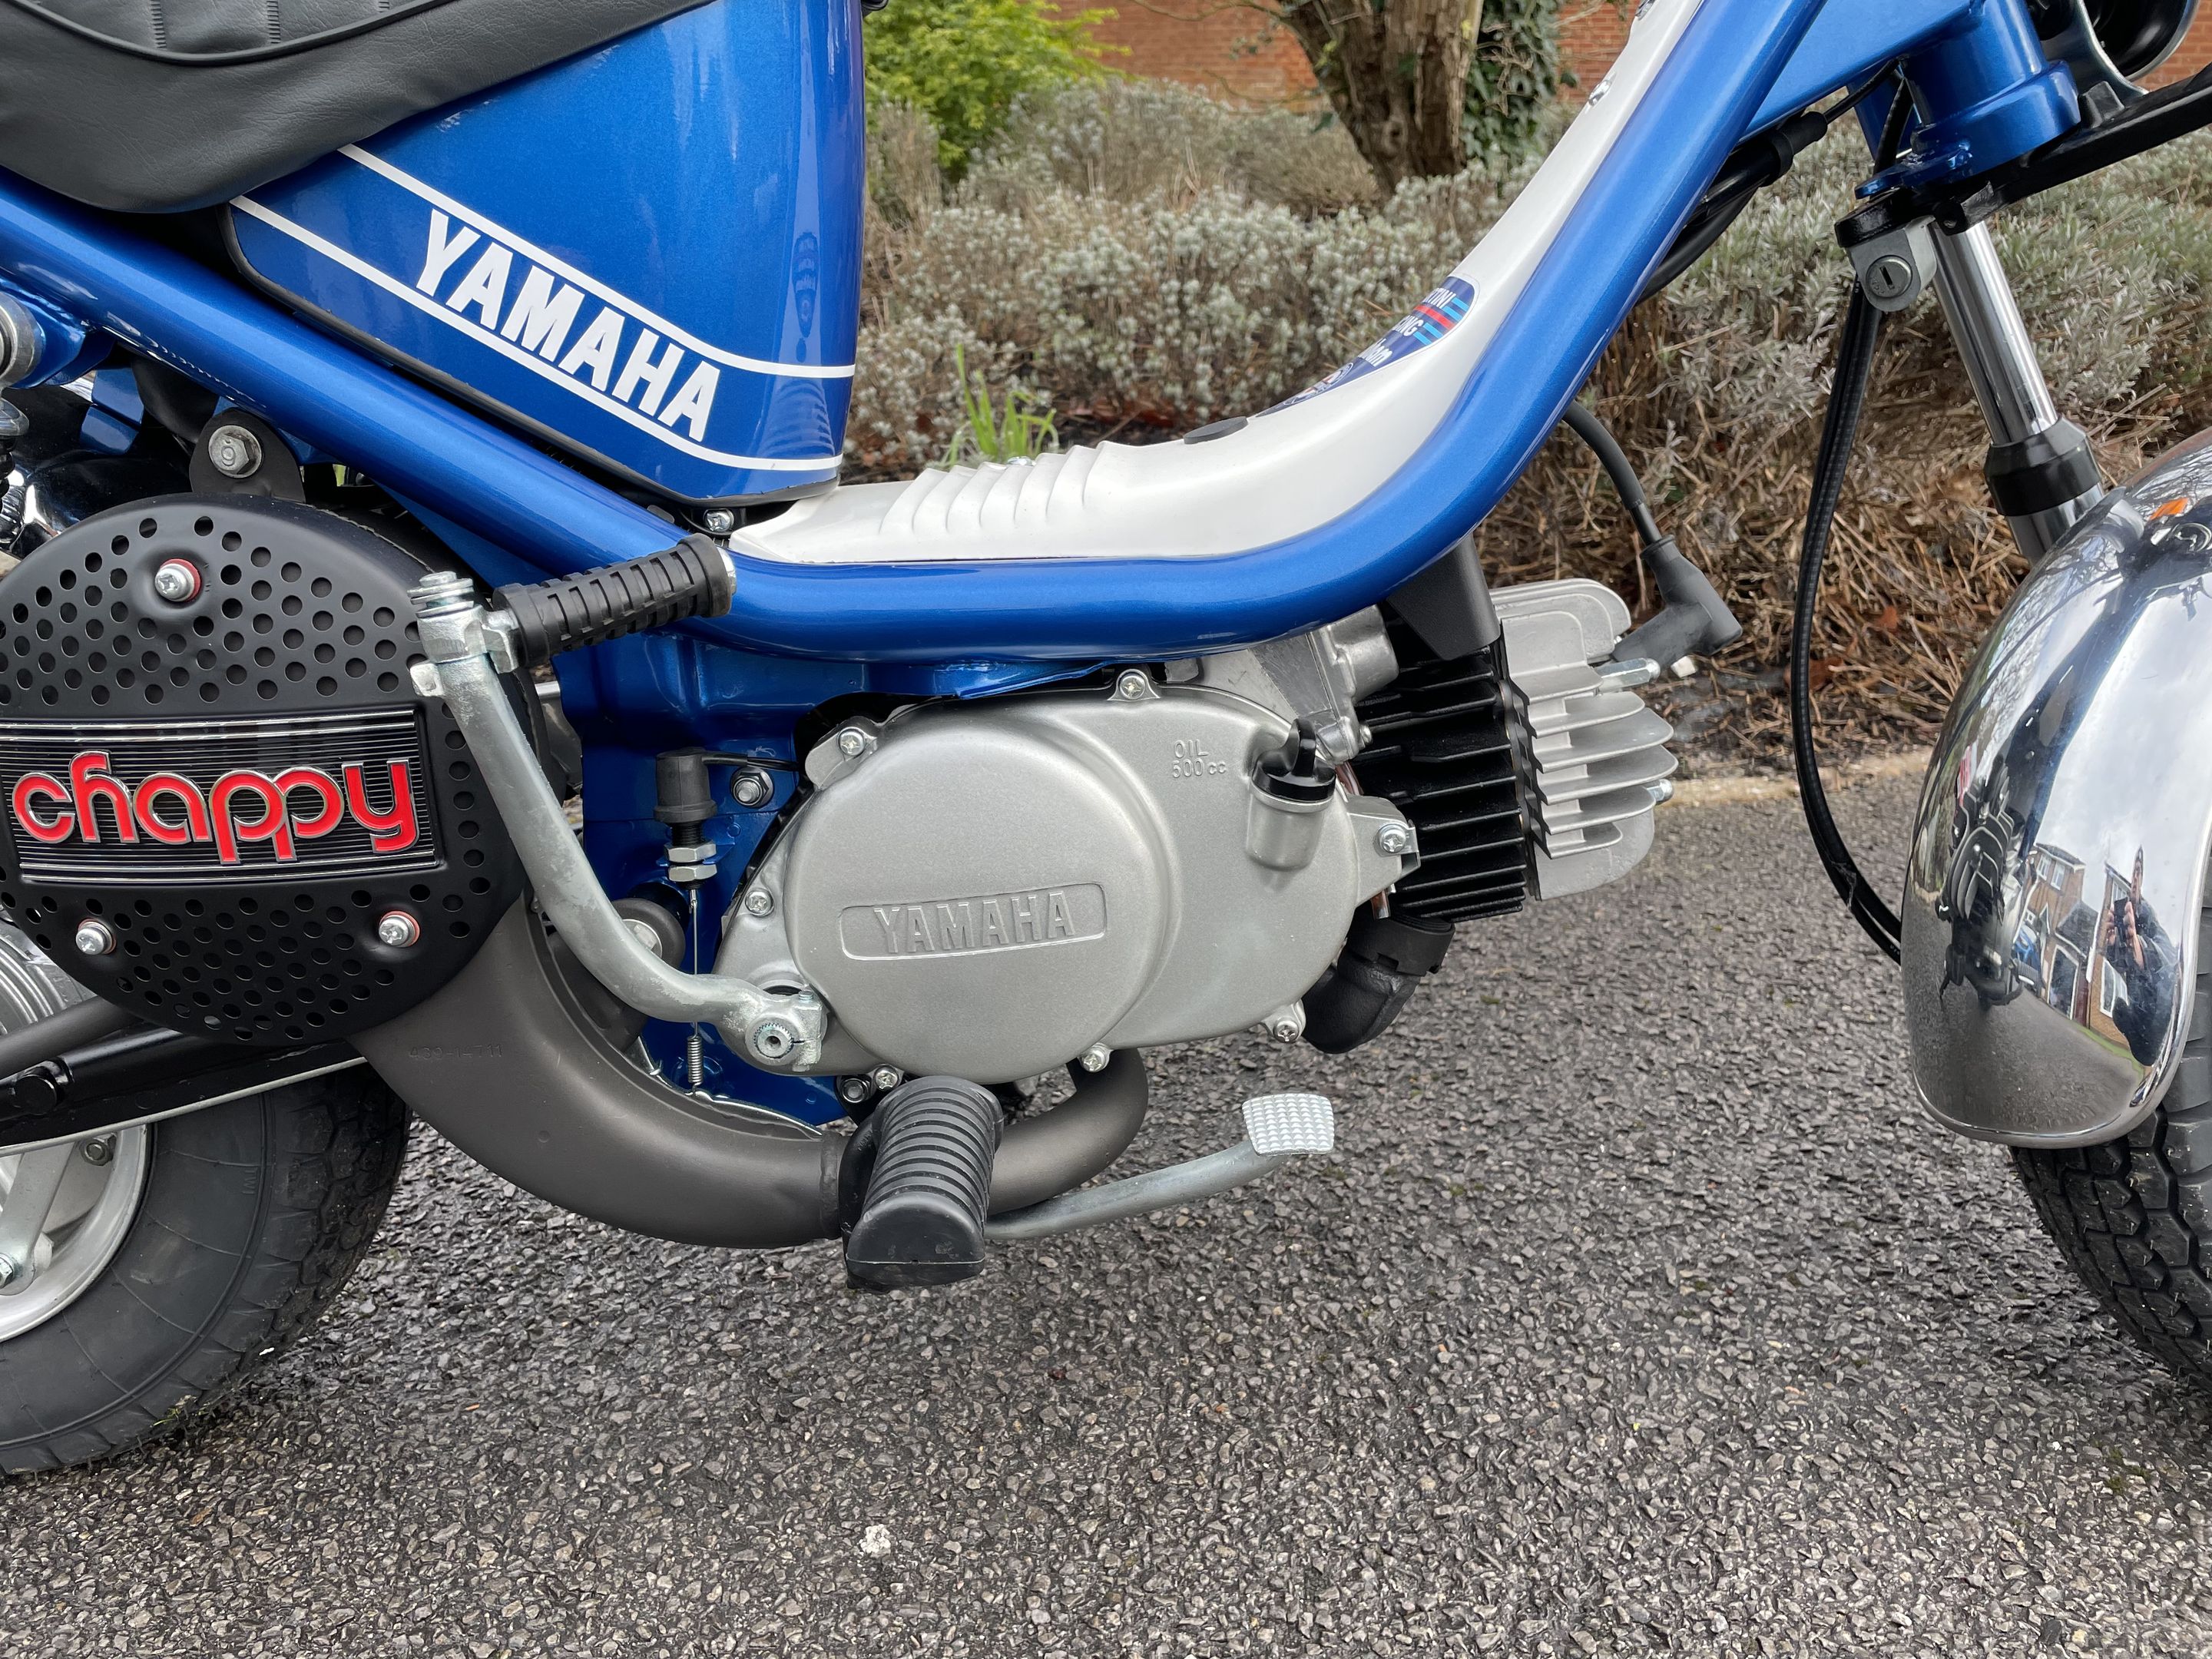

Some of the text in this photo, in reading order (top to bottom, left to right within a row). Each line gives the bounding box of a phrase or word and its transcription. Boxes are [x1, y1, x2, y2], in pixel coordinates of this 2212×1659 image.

[416, 208, 720, 442] YAMAHA
[1173, 739, 1210, 759] OIL
[12, 748, 420, 864] chappy
[873, 890, 1076, 953] YAMAHA
